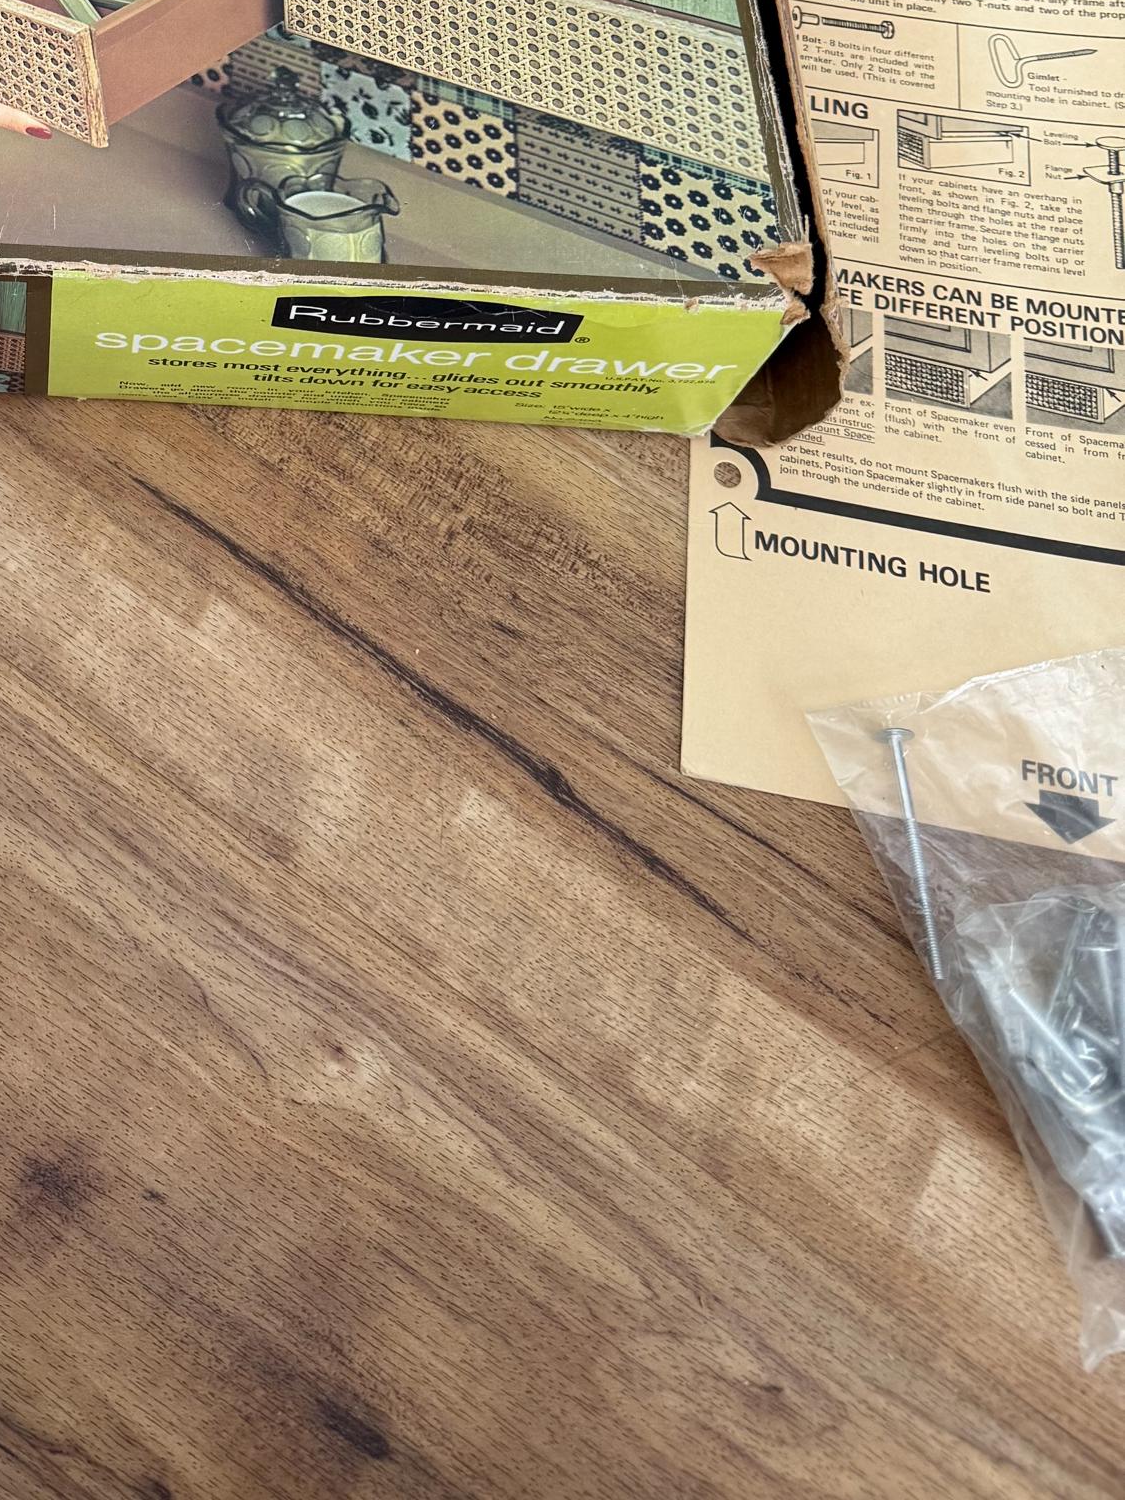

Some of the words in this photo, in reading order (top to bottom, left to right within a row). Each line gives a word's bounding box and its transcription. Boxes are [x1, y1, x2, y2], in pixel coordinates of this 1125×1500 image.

[810, 95, 869, 119] LING
[933, 285, 982, 306] CAN
[991, 293, 1019, 312] BE
[288, 305, 566, 335] Rubbermaid
[875, 293, 1001, 328] DIFFERENT
[1010, 316, 1125, 346] POSITION
[95, 332, 492, 367] spacemaker
[504, 350, 739, 380] drawer
[148, 357, 217, 369] stores
[223, 361, 281, 373] most
[432, 372, 500, 386] glides
[505, 379, 545, 388] out
[253, 373, 294, 383] tilts
[299, 376, 364, 386] down
[371, 379, 402, 388] for
[406, 383, 461, 393] easy
[465, 389, 543, 398] access
[755, 530, 907, 578] MOUNTING
[919, 562, 991, 593] HOLE
[1021, 760, 1118, 797] FRONT
